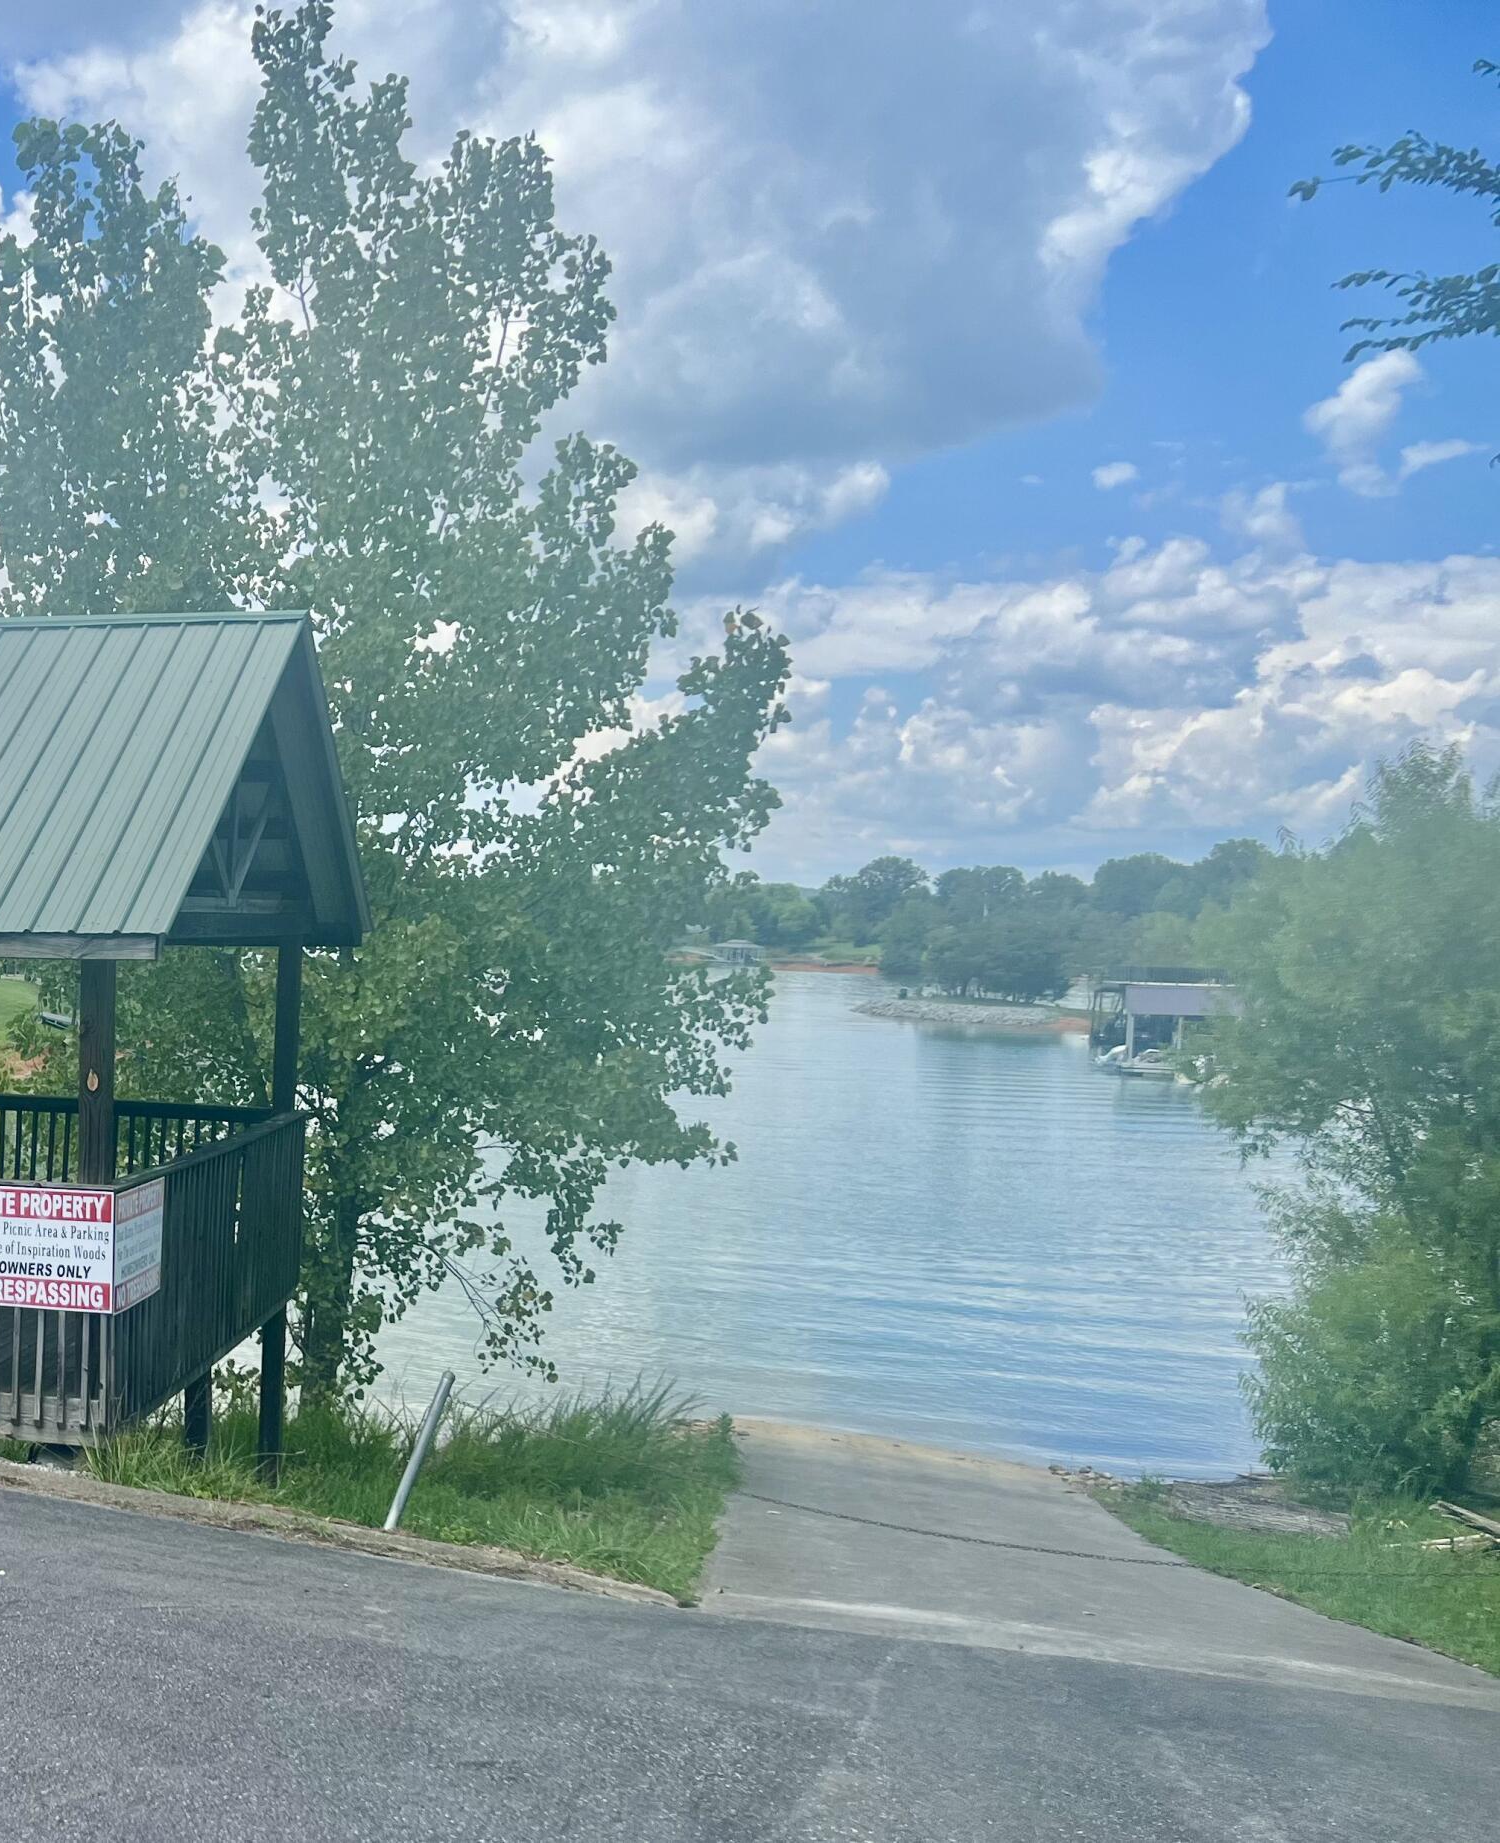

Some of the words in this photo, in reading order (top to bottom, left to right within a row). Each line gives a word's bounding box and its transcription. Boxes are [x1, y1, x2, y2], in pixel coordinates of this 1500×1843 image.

[20, 1192, 106, 1219] PROPERTY
[3, 1222, 33, 1237] Picnic
[35, 1226, 58, 1238] Area
[61, 1228, 68, 1239] &
[70, 1229, 109, 1243] Parking
[5, 1241, 15, 1254] of
[16, 1243, 72, 1260] Inspiration
[74, 1247, 106, 1261] Woods
[57, 1264, 91, 1279] ONLY
